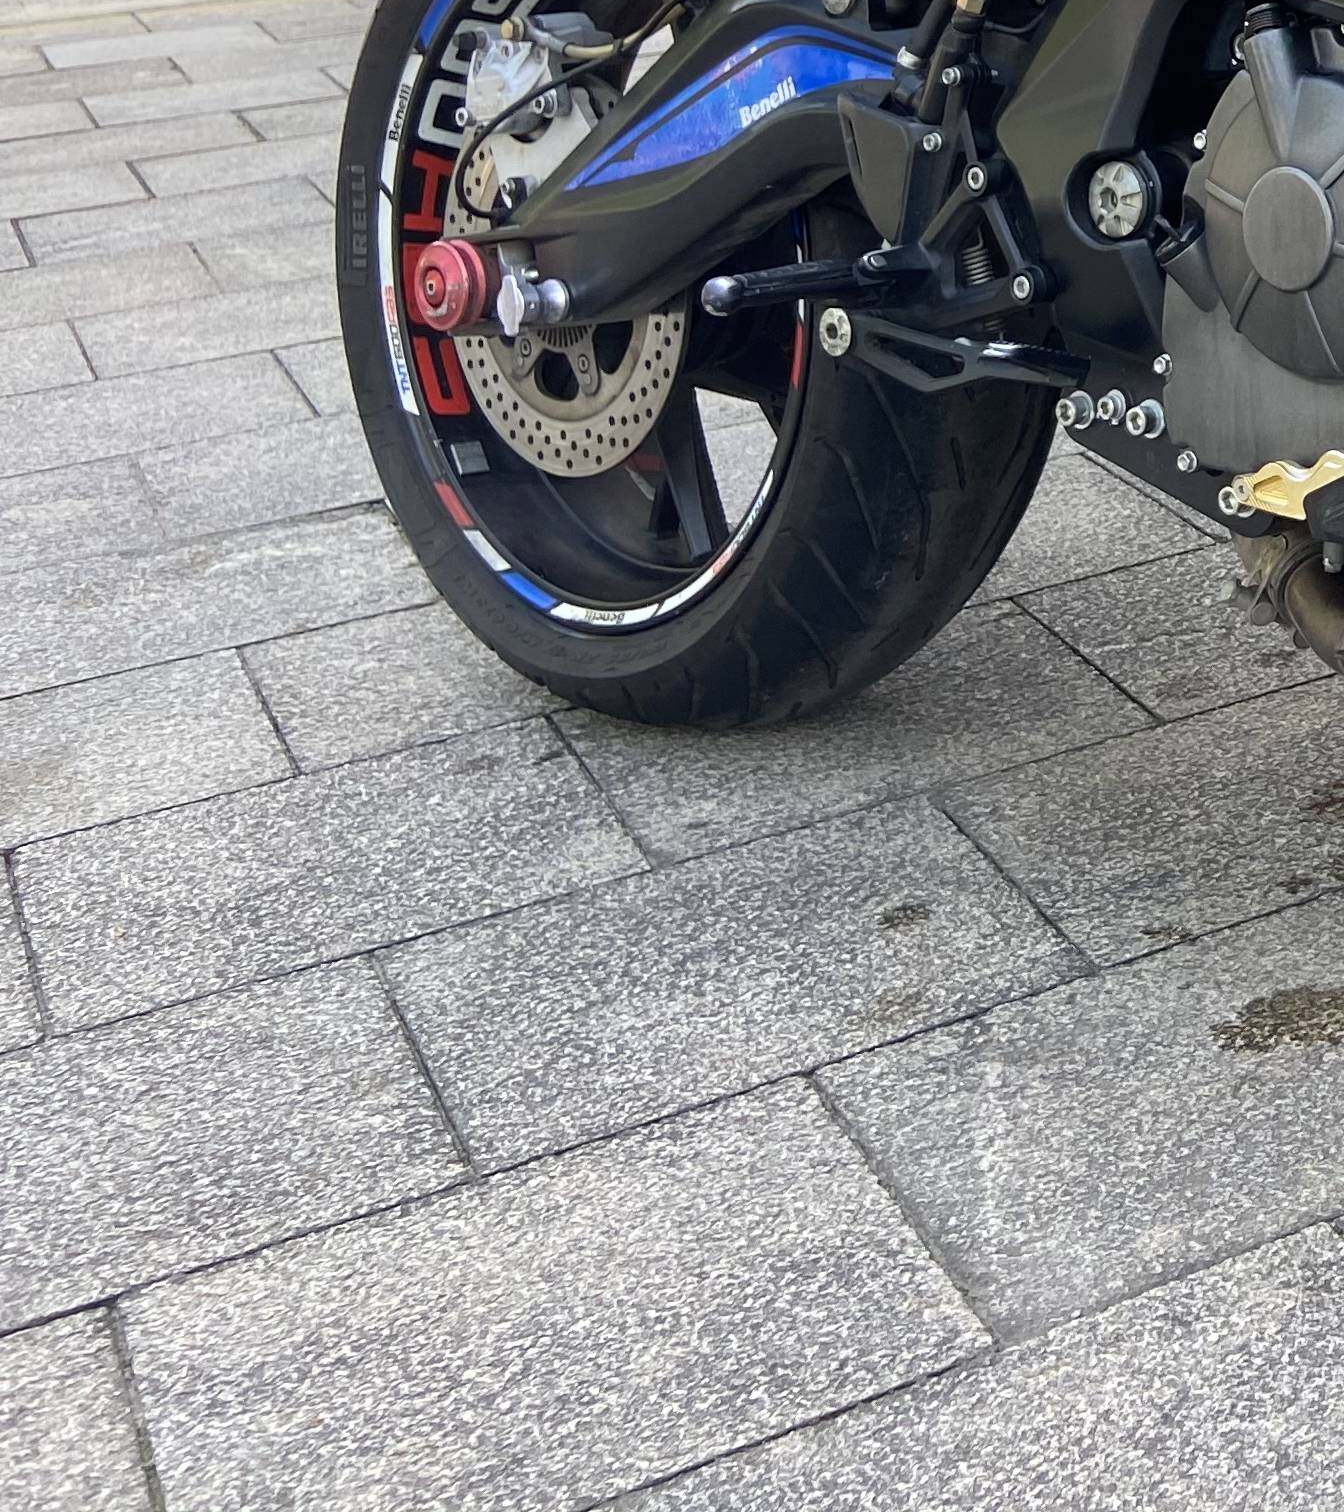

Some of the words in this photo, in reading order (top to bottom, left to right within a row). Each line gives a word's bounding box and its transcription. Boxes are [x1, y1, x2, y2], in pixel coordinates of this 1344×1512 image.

[388, 84, 412, 142] Benelli
[738, 75, 798, 129] Benelli
[584, 609, 626, 625] Benelli
